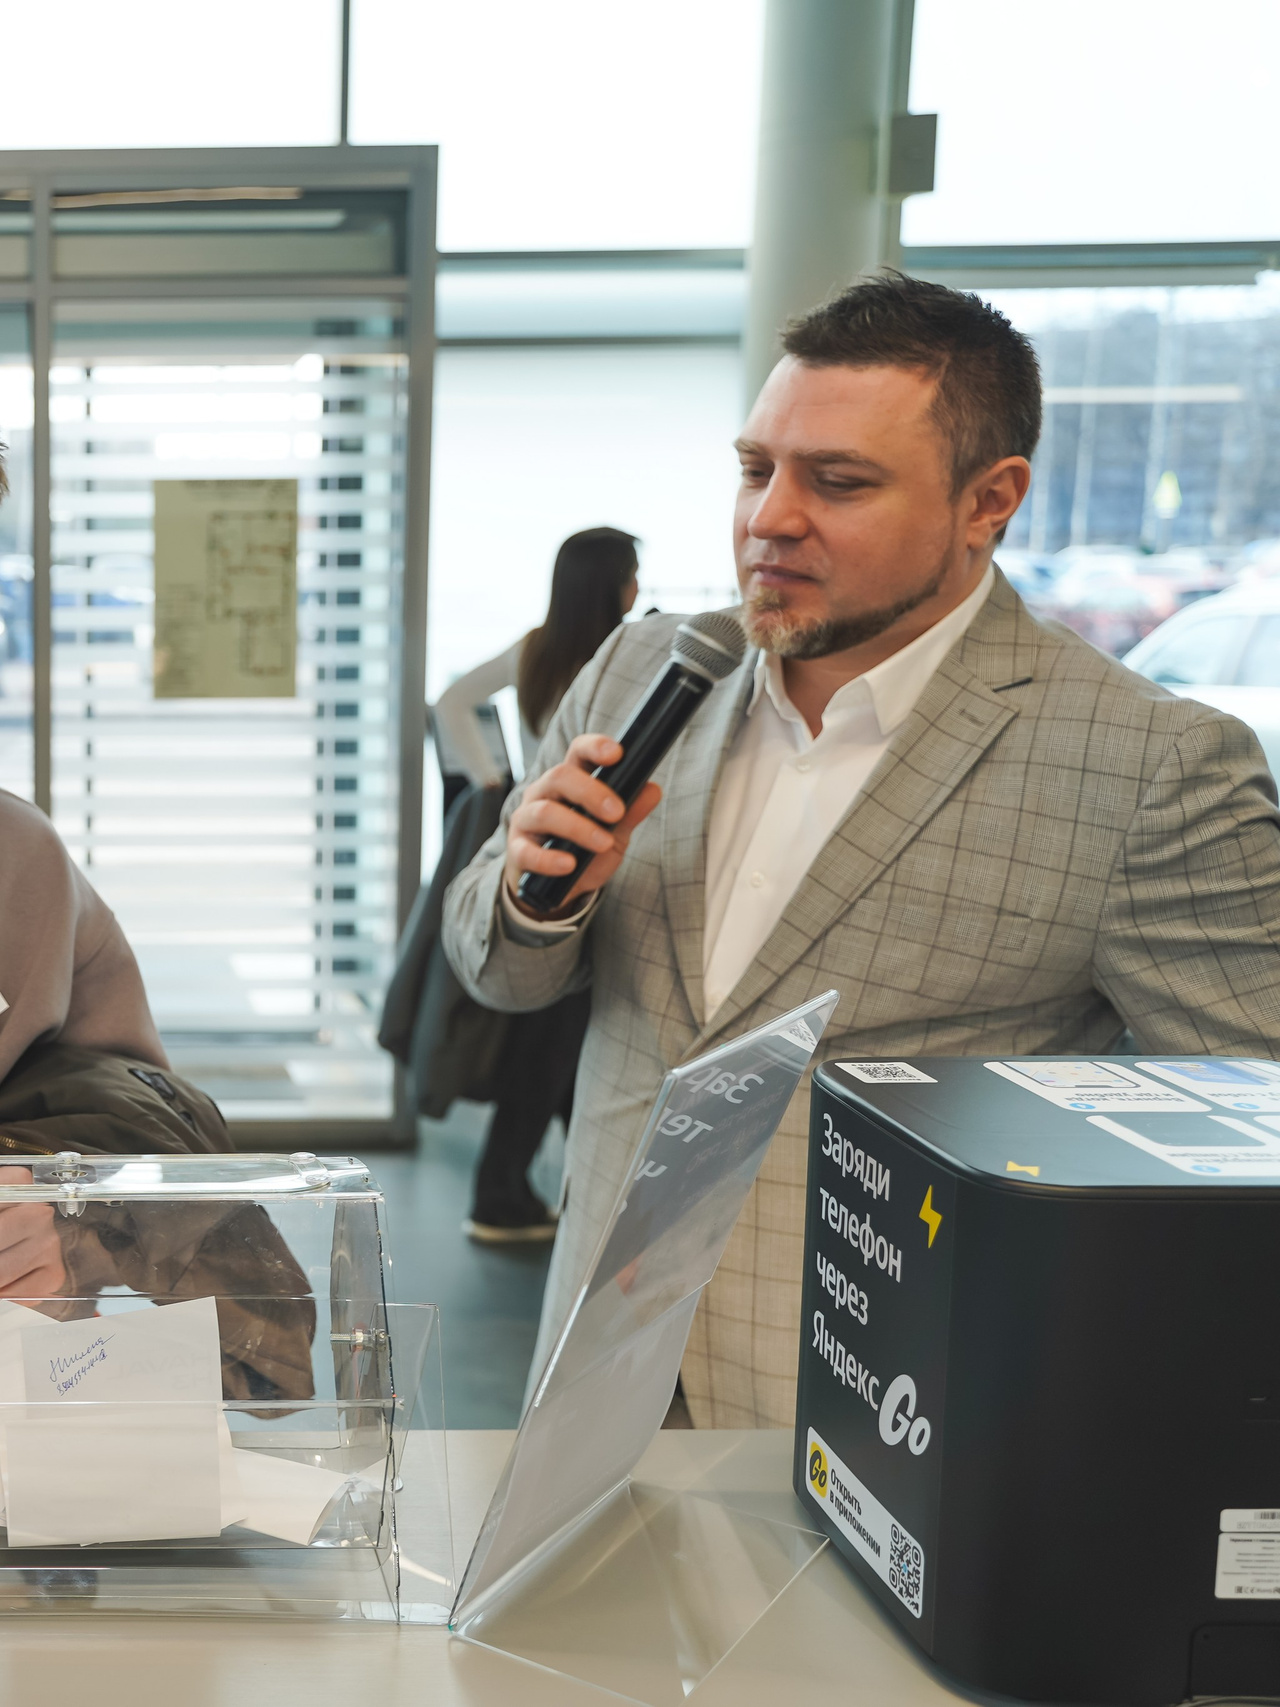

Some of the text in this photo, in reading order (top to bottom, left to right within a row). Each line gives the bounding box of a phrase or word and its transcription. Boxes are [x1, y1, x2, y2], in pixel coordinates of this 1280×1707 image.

[821, 1113, 891, 1201] Заряди
[820, 1187, 902, 1283] телефон
[816, 1251, 869, 1326] через
[812, 1310, 931, 1456] Яндекс Go
[809, 1449, 827, 1488] Go
[830, 1468, 862, 1515] Открыть
[834, 1494, 881, 1558] приложении
